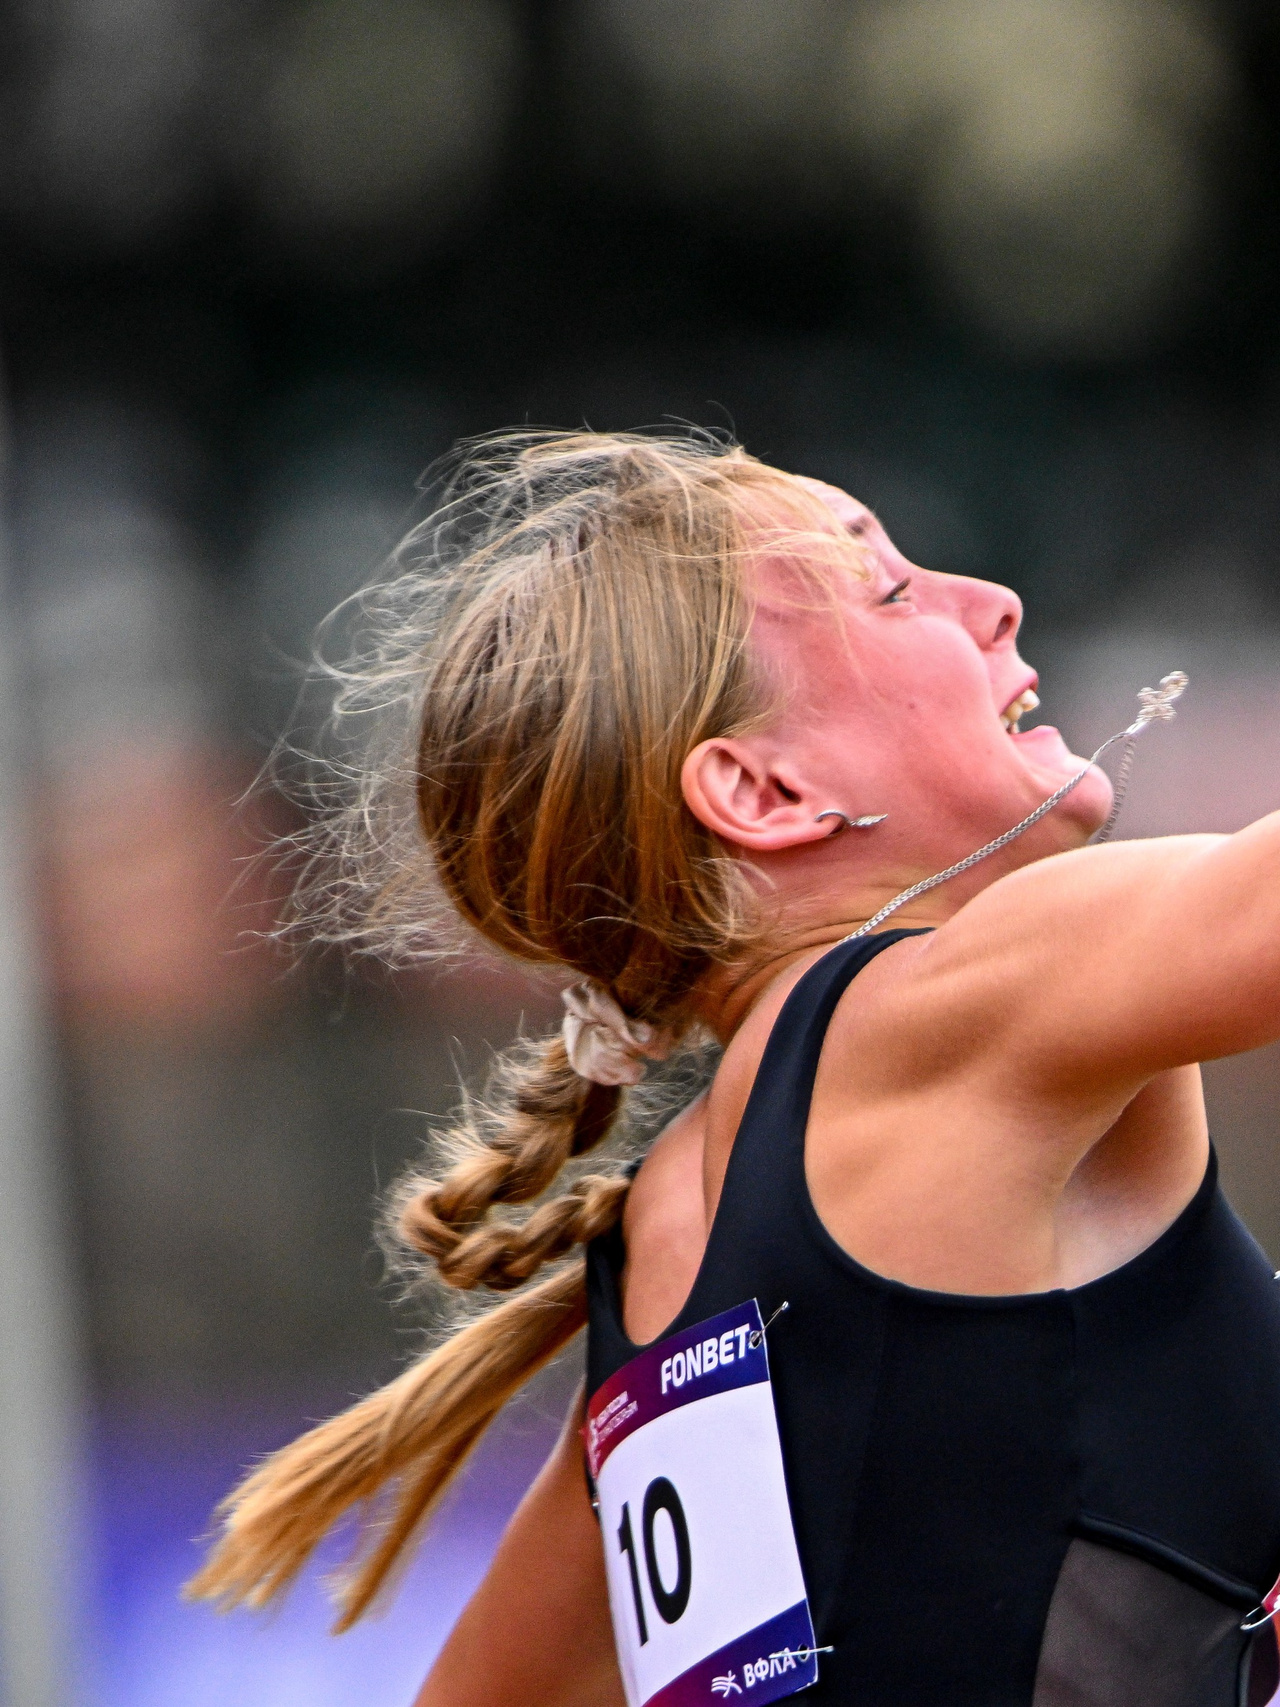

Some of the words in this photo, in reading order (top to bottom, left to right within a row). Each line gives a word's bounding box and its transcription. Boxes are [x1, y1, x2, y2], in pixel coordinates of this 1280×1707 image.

[661, 1323, 750, 1394] FONBET
[617, 1476, 692, 1647] 10
[743, 1647, 797, 1688] ВФЛА
